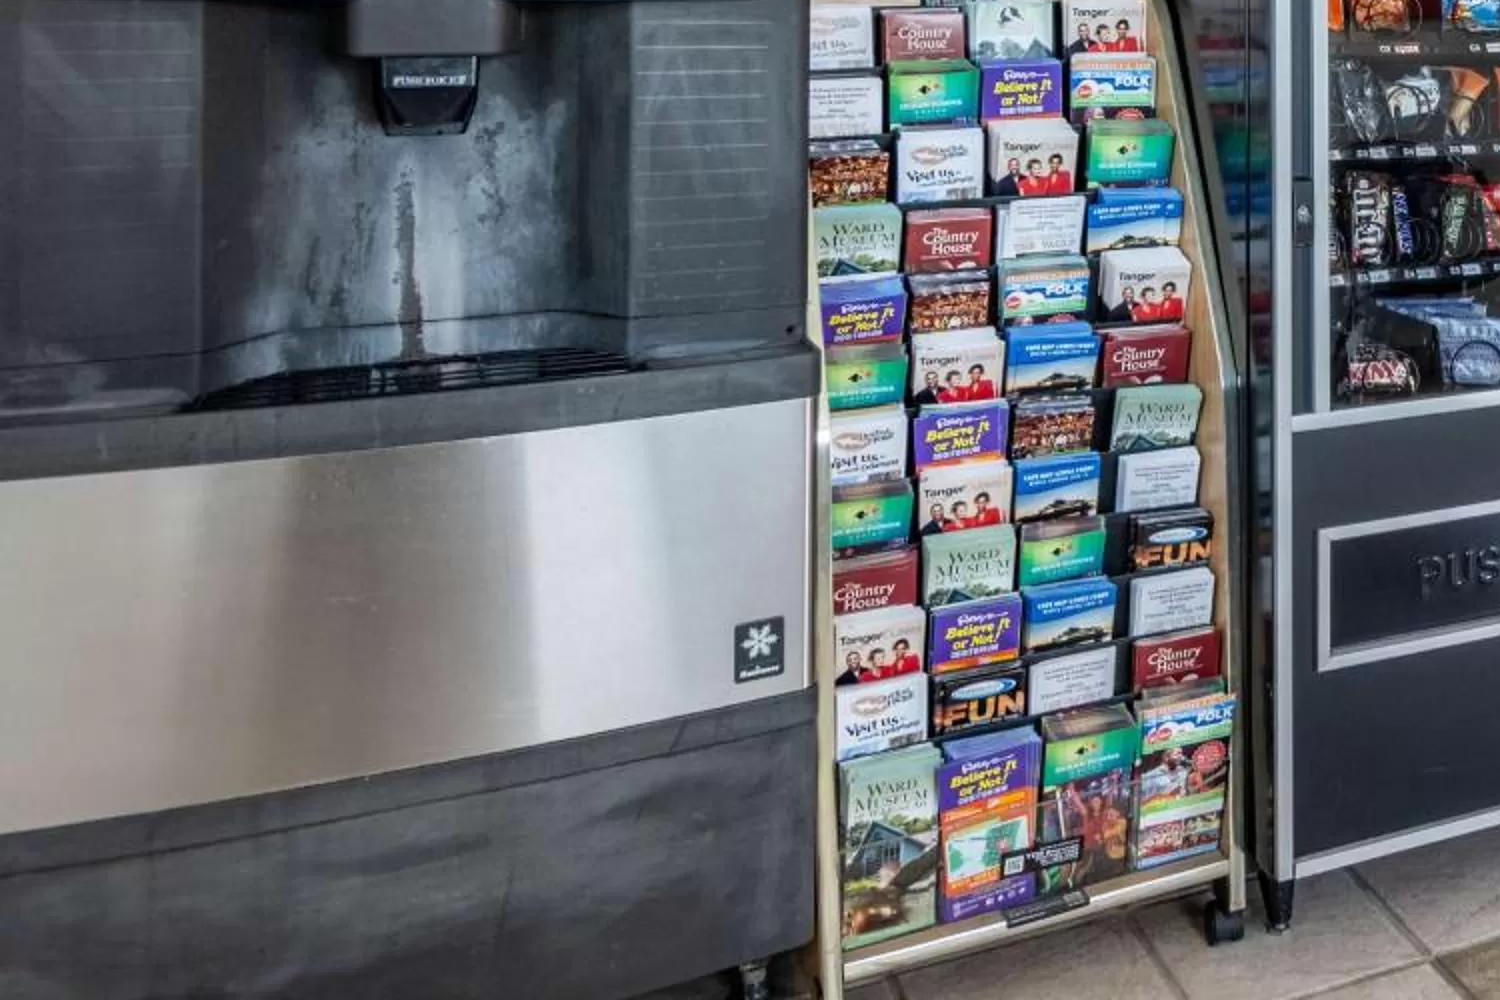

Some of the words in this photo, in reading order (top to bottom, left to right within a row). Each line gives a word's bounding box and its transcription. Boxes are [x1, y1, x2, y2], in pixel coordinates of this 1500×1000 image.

[1072, 7, 1109, 19] Tanger
[898, 26, 952, 40] Country
[907, 38, 948, 51] House
[1114, 75, 1150, 88] FOLK
[923, 231, 979, 245] Country
[931, 243, 973, 256] House
[1045, 282, 1084, 296] FOLK
[1113, 348, 1165, 364] Country
[1121, 360, 1158, 374] House
[834, 584, 896, 601] Country
[844, 596, 889, 612] House
[1148, 645, 1203, 666] Country
[1156, 658, 1195, 674] House
[943, 690, 1025, 728] FUN
[1195, 705, 1233, 724] FOLK
